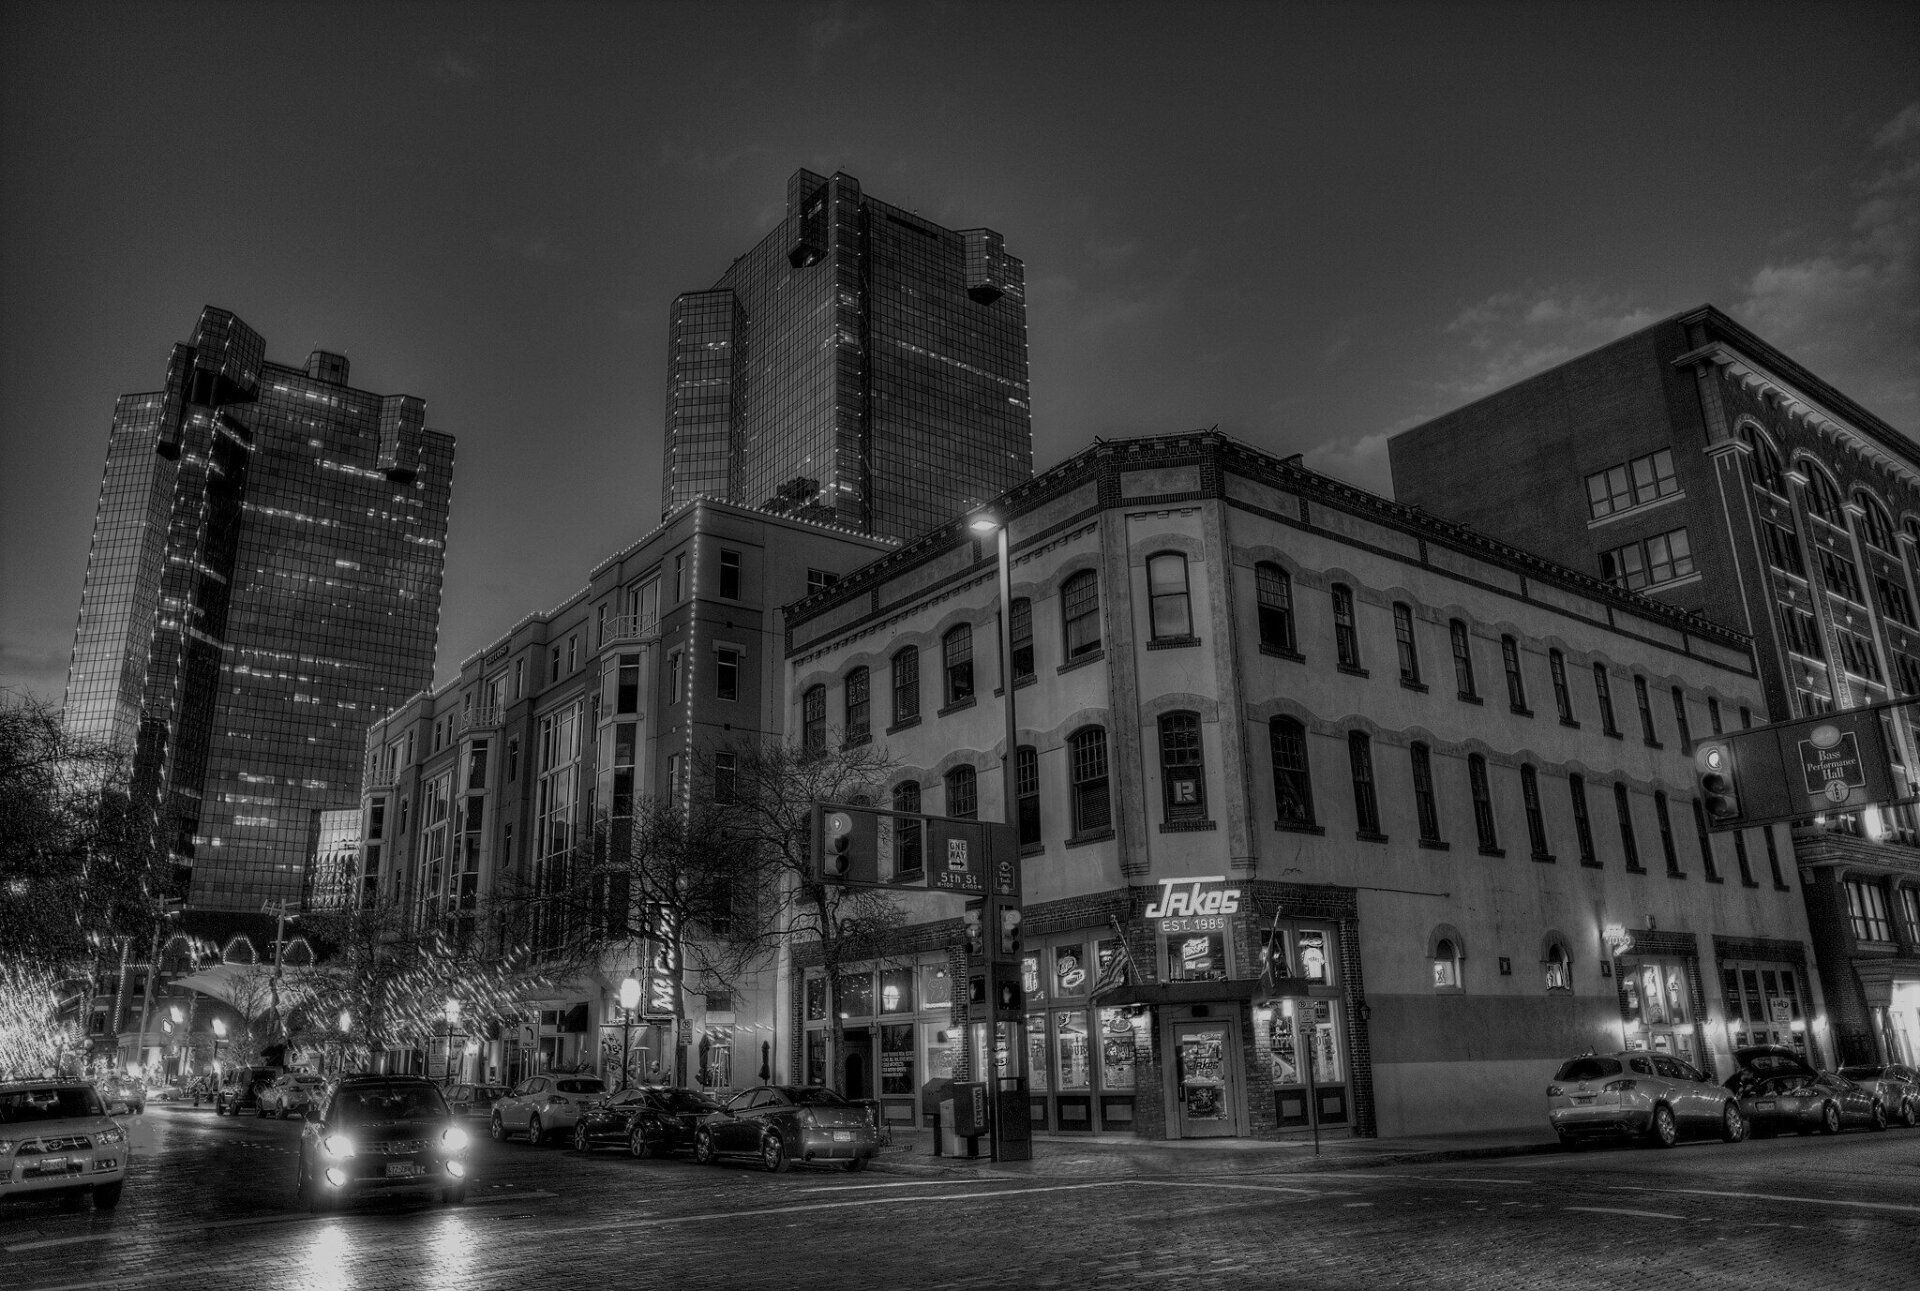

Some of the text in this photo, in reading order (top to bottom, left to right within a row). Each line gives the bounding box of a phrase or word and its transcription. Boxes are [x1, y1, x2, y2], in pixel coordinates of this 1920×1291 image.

[1818, 750, 1841, 761] Bass
[1806, 758, 1856, 772] Performance
[1822, 766, 1844, 780] Hall
[949, 841, 966, 851] ONE
[949, 850, 966, 860] WAY
[940, 871, 977, 885] 5th St
[1162, 918, 1225, 932] EST. 1985
